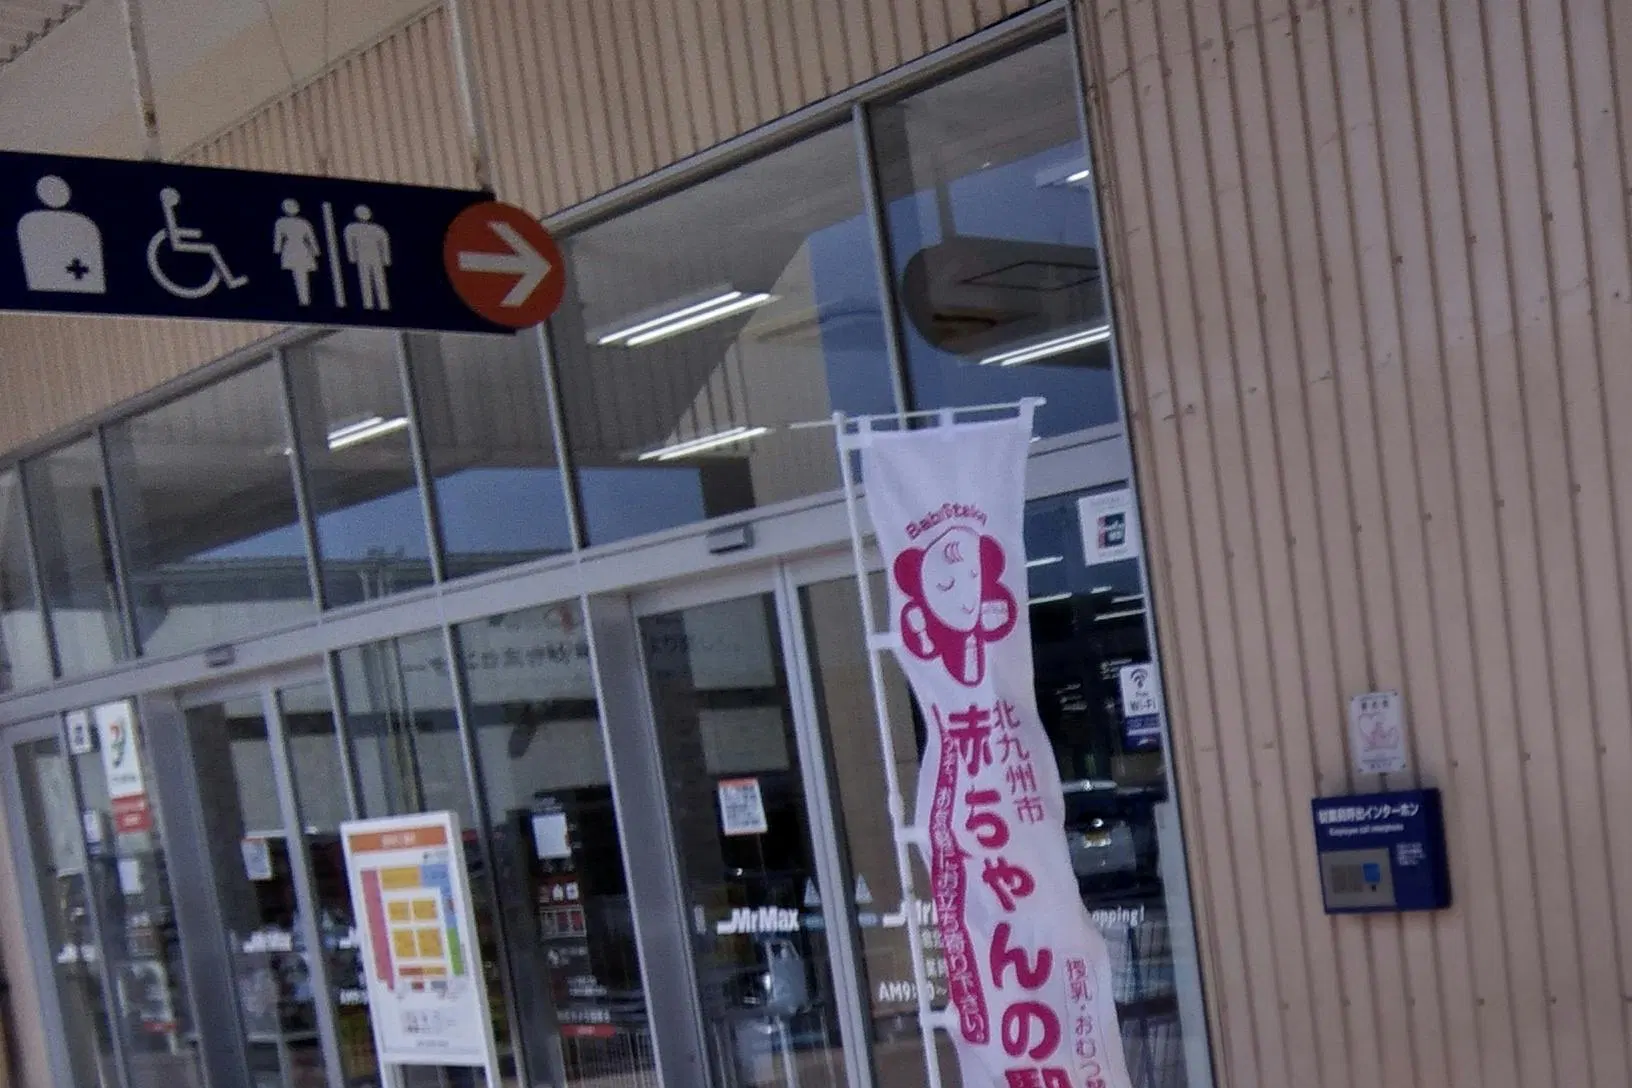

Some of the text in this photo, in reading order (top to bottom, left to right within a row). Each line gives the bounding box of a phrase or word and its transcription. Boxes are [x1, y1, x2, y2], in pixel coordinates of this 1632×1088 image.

[993, 700, 1045, 824] 北九州市
[727, 905, 800, 933] MrMax
